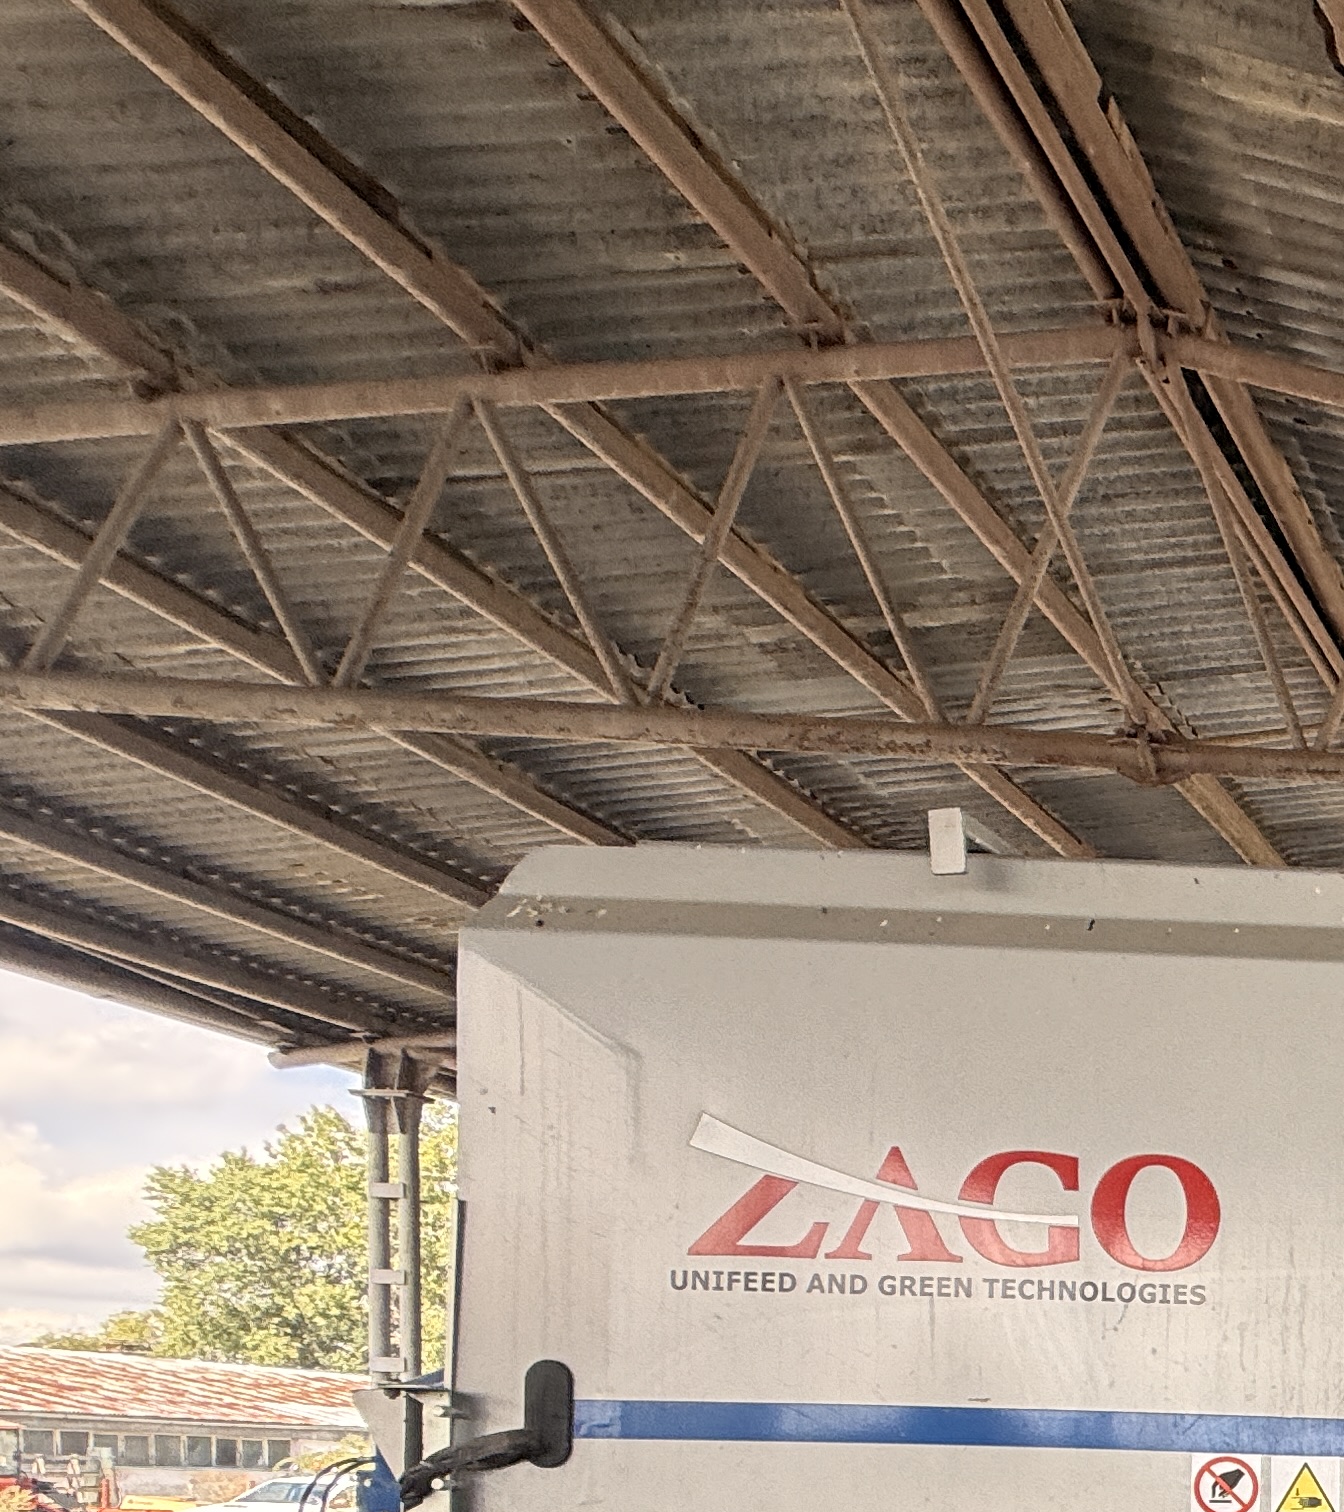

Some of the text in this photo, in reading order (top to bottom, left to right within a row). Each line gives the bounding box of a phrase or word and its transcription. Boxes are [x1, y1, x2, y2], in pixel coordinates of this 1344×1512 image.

[687, 1145, 1222, 1273] ZAGO
[669, 1268, 1208, 1307] UNIFEED AND GREEN TECHNOLOGIES
